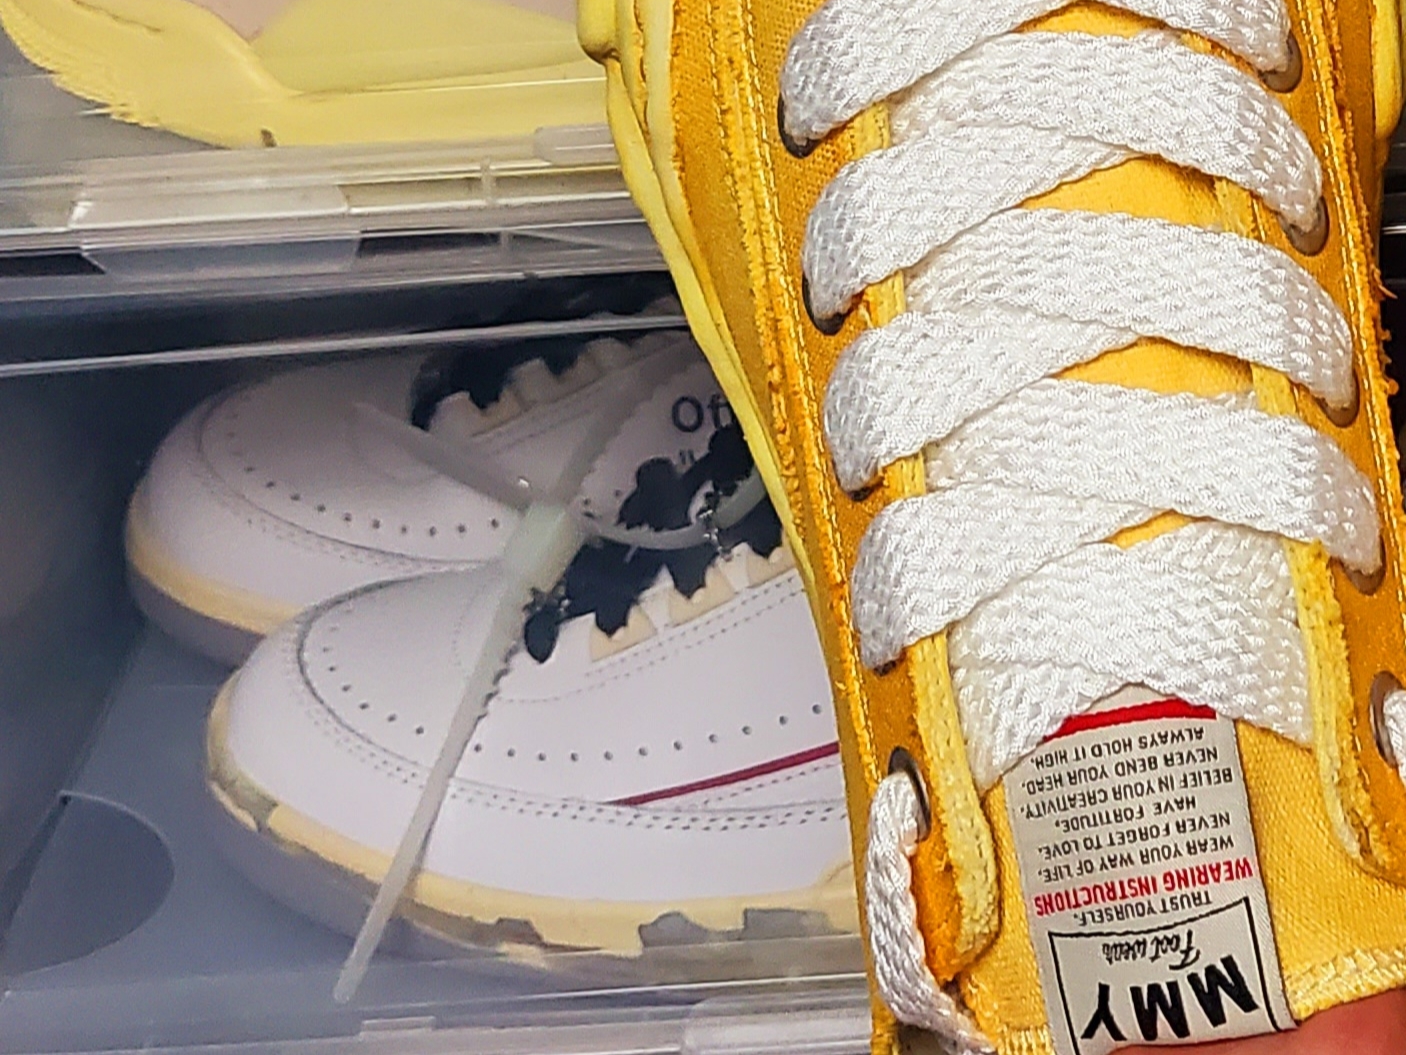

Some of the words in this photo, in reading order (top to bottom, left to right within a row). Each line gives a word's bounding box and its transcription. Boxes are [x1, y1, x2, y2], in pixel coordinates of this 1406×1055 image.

[1091, 738, 1132, 758] HOLD
[1138, 727, 1204, 749] ALWAYS
[1073, 746, 1085, 762] IT
[1164, 746, 1217, 767] NEVER
[1067, 765, 1108, 786] YOUR
[1115, 757, 1157, 777] BEND
[1158, 775, 1174, 793] IN
[1179, 767, 1232, 789] BELIEF
[1112, 780, 1155, 802] YOUR
[1153, 796, 1196, 815] HAVE
[1176, 812, 1230, 834] NEVER
[1083, 835, 1101, 851] TO
[1107, 823, 1170, 847] FORGET
[1186, 835, 1234, 856] WEAR
[1038, 840, 1078, 860] LOVE.
[1139, 844, 1182, 865] YOUR
[1077, 860, 1093, 875] OF
[1100, 853, 1134, 872] WAY
[1163, 857, 1253, 892] WEARING
[1034, 875, 1158, 917] INSTRUCTIONS
[1160, 890, 1211, 914] TRUST
[1073, 899, 1156, 926] YOURSELF.
[1080, 955, 1259, 1041] MMY
